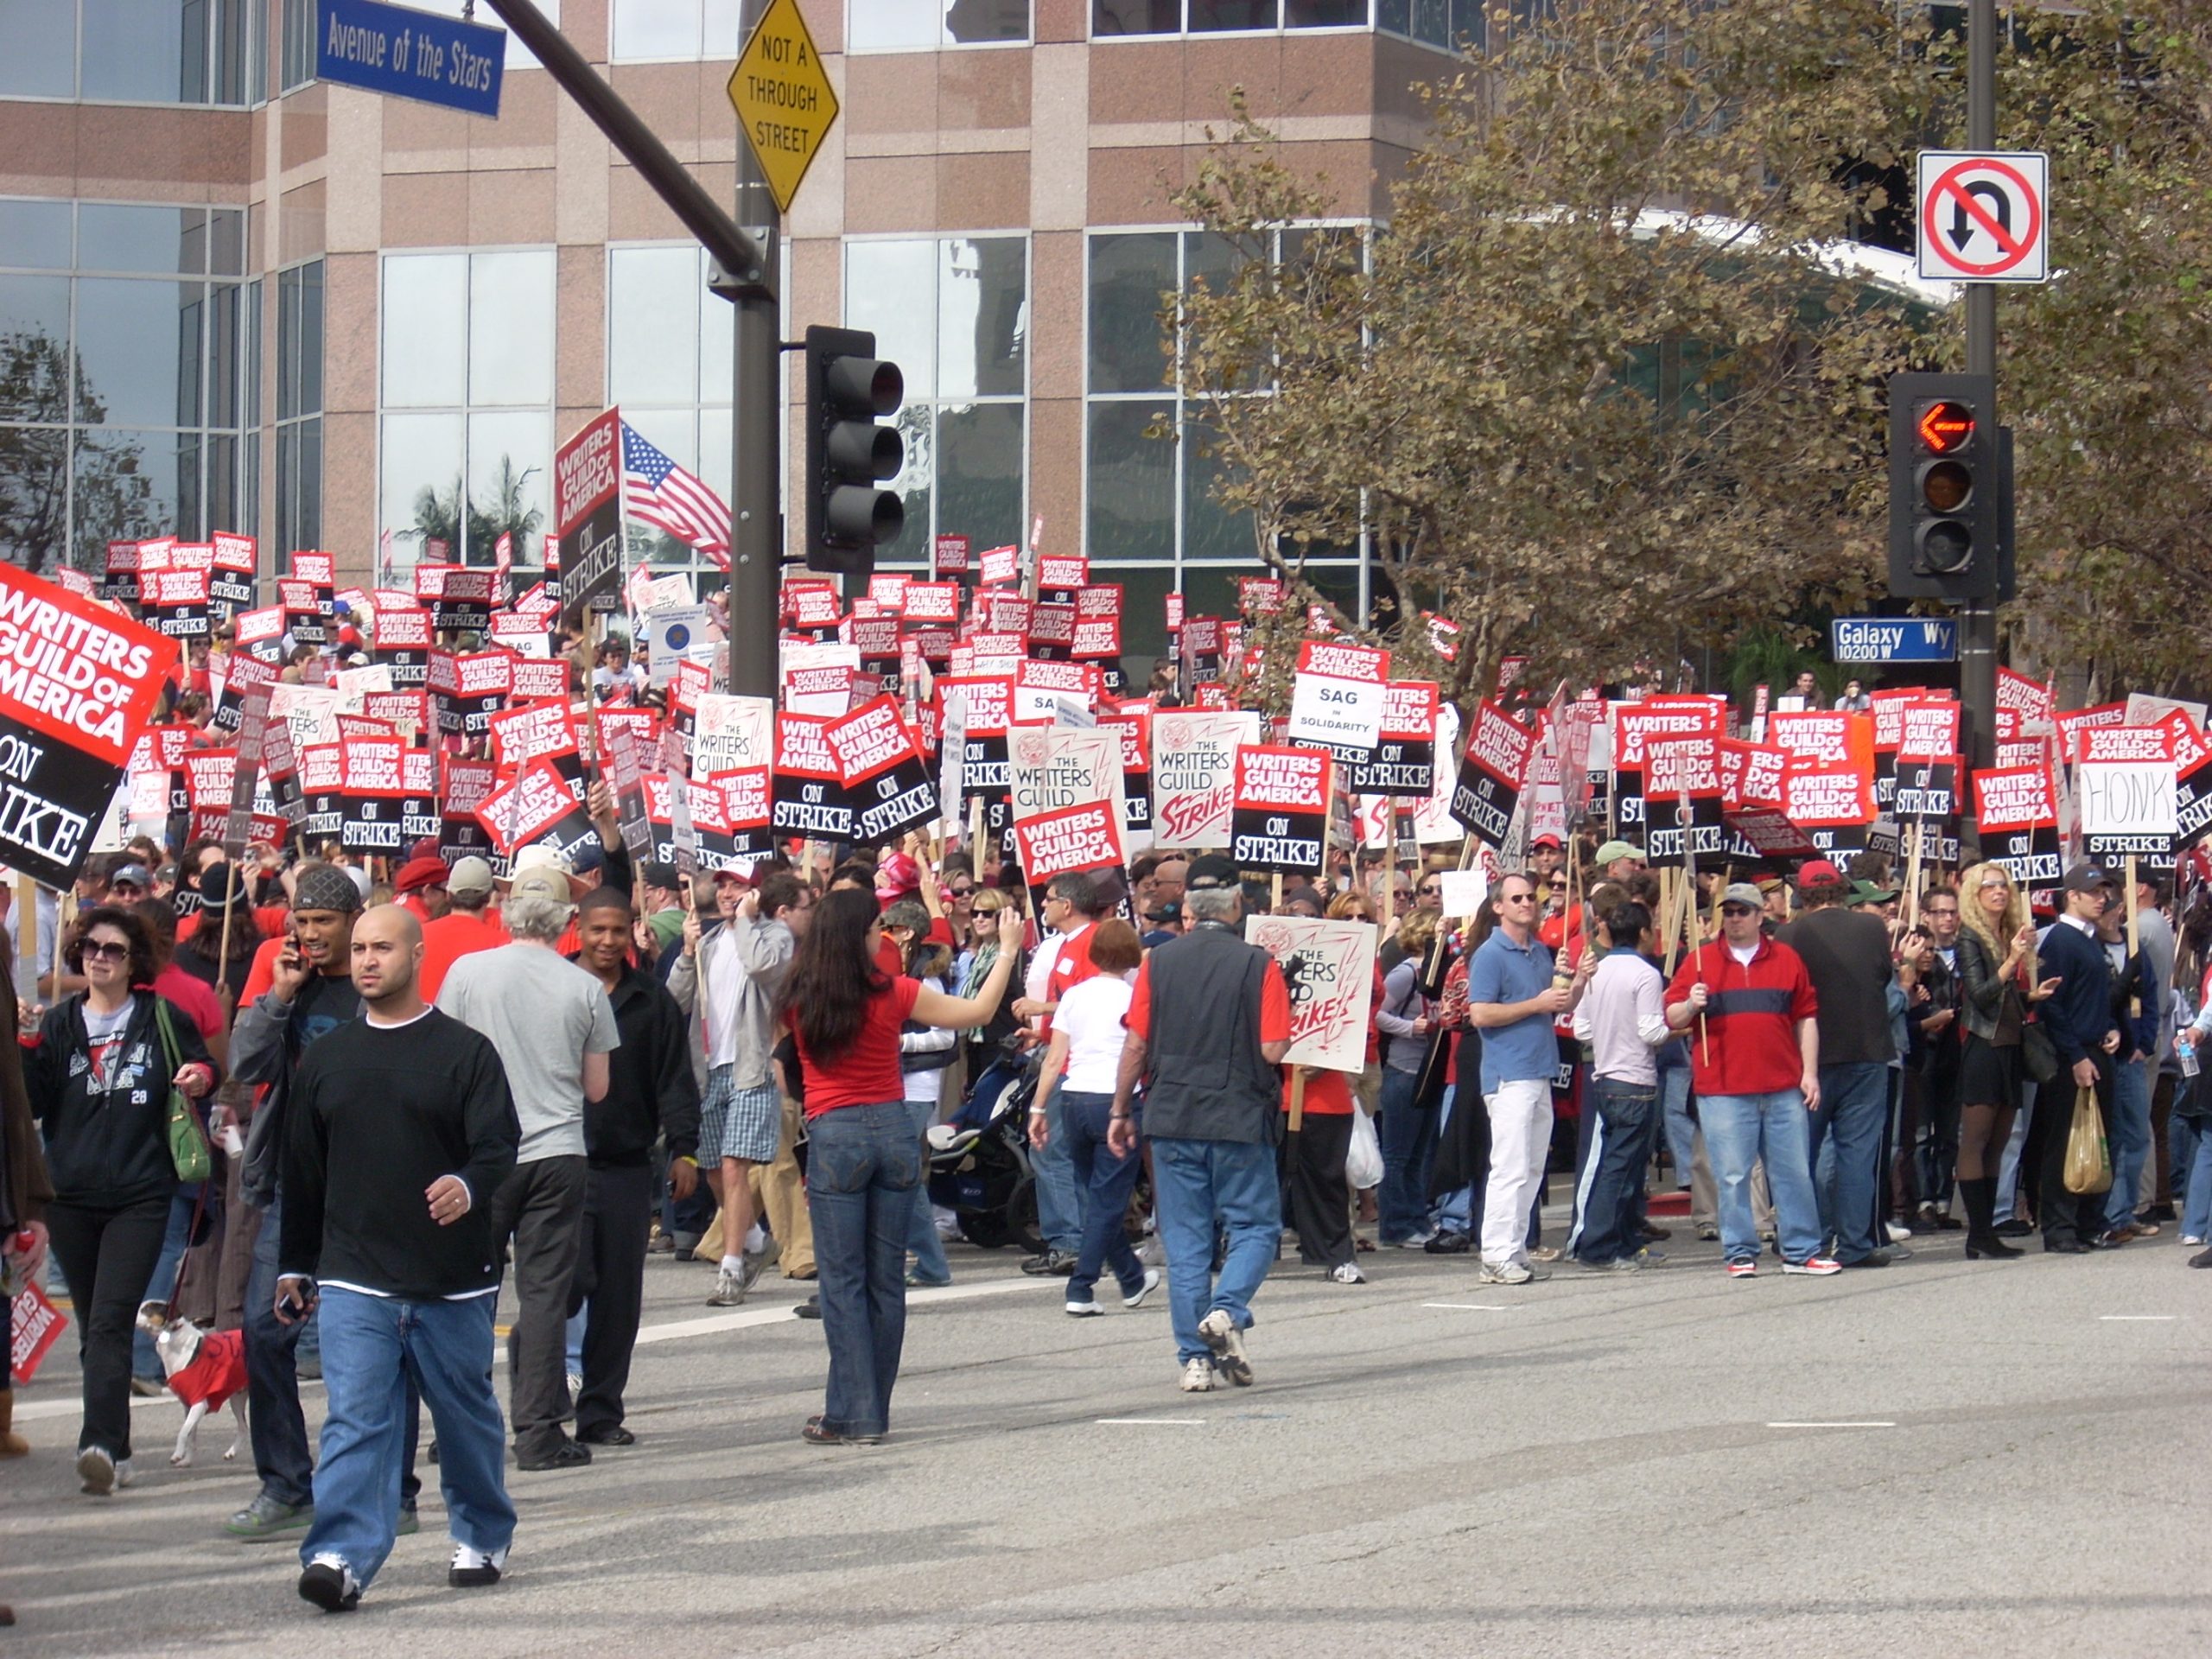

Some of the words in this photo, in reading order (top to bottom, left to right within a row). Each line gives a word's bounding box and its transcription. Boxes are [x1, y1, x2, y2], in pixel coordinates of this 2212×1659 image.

[327, 11, 386, 68] Avenue
[393, 28, 411, 72] of
[417, 34, 444, 80] the
[449, 40, 493, 92] Stars
[762, 35, 791, 63] NOT
[797, 42, 808, 67] A
[747, 76, 817, 113] THROUGH
[756, 120, 809, 154] STREET
[559, 423, 613, 481] WRITERS
[563, 460, 597, 501] GUILD
[598, 449, 611, 468] OF
[562, 466, 614, 526] AMERICA
[579, 523, 594, 554] ON
[563, 534, 617, 611] STRIKE
[1041, 559, 1084, 571] WRITERS
[1043, 568, 1071, 578] GUILD
[1040, 575, 1085, 588] AMERICA
[796, 591, 832, 604] WRITERS
[905, 587, 954, 600] WRITERS
[907, 597, 941, 608] GUILD
[941, 598, 954, 608] OF
[1054, 591, 1068, 602] ON
[799, 602, 823, 613] GUILD
[799, 611, 836, 623] AMERICA
[904, 607, 955, 617] AMERICA
[377, 613, 427, 625] WRITERS
[0, 582, 152, 680] WRITERS
[378, 632, 429, 647] AMERICA
[380, 624, 410, 636] GUILD
[812, 630, 823, 641] ON
[1839, 623, 1904, 651] Galaxy
[1923, 623, 1952, 651] Wy
[396, 653, 411, 664] ON
[1310, 645, 1381, 664] WRITERS
[1839, 645, 1878, 660] 10200
[1881, 645, 1893, 660] W
[512, 663, 564, 676] WRITERS
[1311, 654, 1362, 669] GUILD
[1362, 659, 1376, 671] OF
[514, 674, 550, 685] GUILD
[1305, 663, 1380, 682] AMERICA
[92, 678, 134, 709] OF
[512, 685, 564, 696] AMERICA
[1319, 689, 1358, 705] SAG
[1999, 673, 2049, 705] WRITERS
[0, 659, 125, 748] MERICA
[1034, 697, 1055, 710] SA
[827, 704, 893, 747] WRITERS
[1300, 716, 1370, 734] SOLIDARITY
[1622, 716, 1703, 733] WRITERS
[1774, 717, 1846, 734] WRITERS
[1904, 709, 1955, 726] WRITERS
[2060, 709, 2123, 733] WRITERS
[727, 725, 741, 735] THE
[781, 719, 823, 739] WRIT
[1482, 708, 1529, 750] WRITERS
[2088, 728, 2166, 741] WRITERS
[700, 734, 751, 755] WRITERS
[783, 735, 830, 755] GUIL
[838, 729, 883, 761] GUILD
[883, 723, 899, 740] OF
[1197, 741, 1217, 751] THE
[1478, 728, 1511, 758] GUILD
[1510, 750, 1523, 765] OF
[1777, 733, 1827, 748] GUILD
[1826, 734, 1844, 747] OF
[2089, 741, 2145, 751] GUILD
[2145, 741, 2163, 751] OF
[346, 743, 400, 760] WRITERS
[843, 735, 911, 780] AMERICA
[965, 743, 985, 761] ON
[1381, 745, 1402, 763] ON
[2086, 749, 2169, 761] AMERICA
[348, 760, 382, 774] GUILD
[383, 761, 398, 774] OF
[778, 751, 838, 772] AMERI
[1055, 758, 1078, 767] THE
[1160, 752, 1230, 771] WRITERS
[1242, 752, 1322, 774] WRITERS
[1470, 741, 1521, 784] AMERICA
[345, 774, 402, 790] AMERICA
[1159, 772, 1213, 791] GUILD
[1244, 769, 1300, 788] GUILD
[1300, 775, 1320, 788] OF
[1354, 763, 1431, 788] STRIKE
[1788, 773, 1859, 791] WRITERS
[1978, 772, 2047, 795] WRITERS
[802, 784, 823, 804] ON
[876, 775, 899, 800] ON
[1239, 785, 1323, 806] AMERICA
[1478, 778, 1495, 797] ON
[1789, 790, 1840, 805] GUILD
[1839, 791, 1858, 804] OF
[1984, 793, 2031, 809] GUILD
[2083, 769, 2171, 828] HONK
[361, 803, 378, 820] ON
[773, 800, 852, 834] STRIKE
[861, 781, 936, 839] STRIKE
[1160, 784, 1234, 840] STRIKE
[1453, 785, 1509, 840] STRIKE
[1786, 802, 1863, 820] AMERICA
[1982, 804, 2054, 827] AMERICA
[0, 782, 89, 866] IKE
[1023, 809, 1105, 842] WRITERS
[1266, 817, 1290, 836] ON
[342, 823, 401, 848] STRIKE
[1031, 831, 1087, 859] GUILD
[1087, 830, 1107, 847] OF
[1812, 831, 1834, 849] ON
[2089, 836, 2171, 853] STRIKE
[1234, 835, 1320, 868] STRIKE
[2009, 836, 2030, 855] ON
[1032, 842, 1116, 877] AMERICA
[1299, 950, 1324, 960] THE
